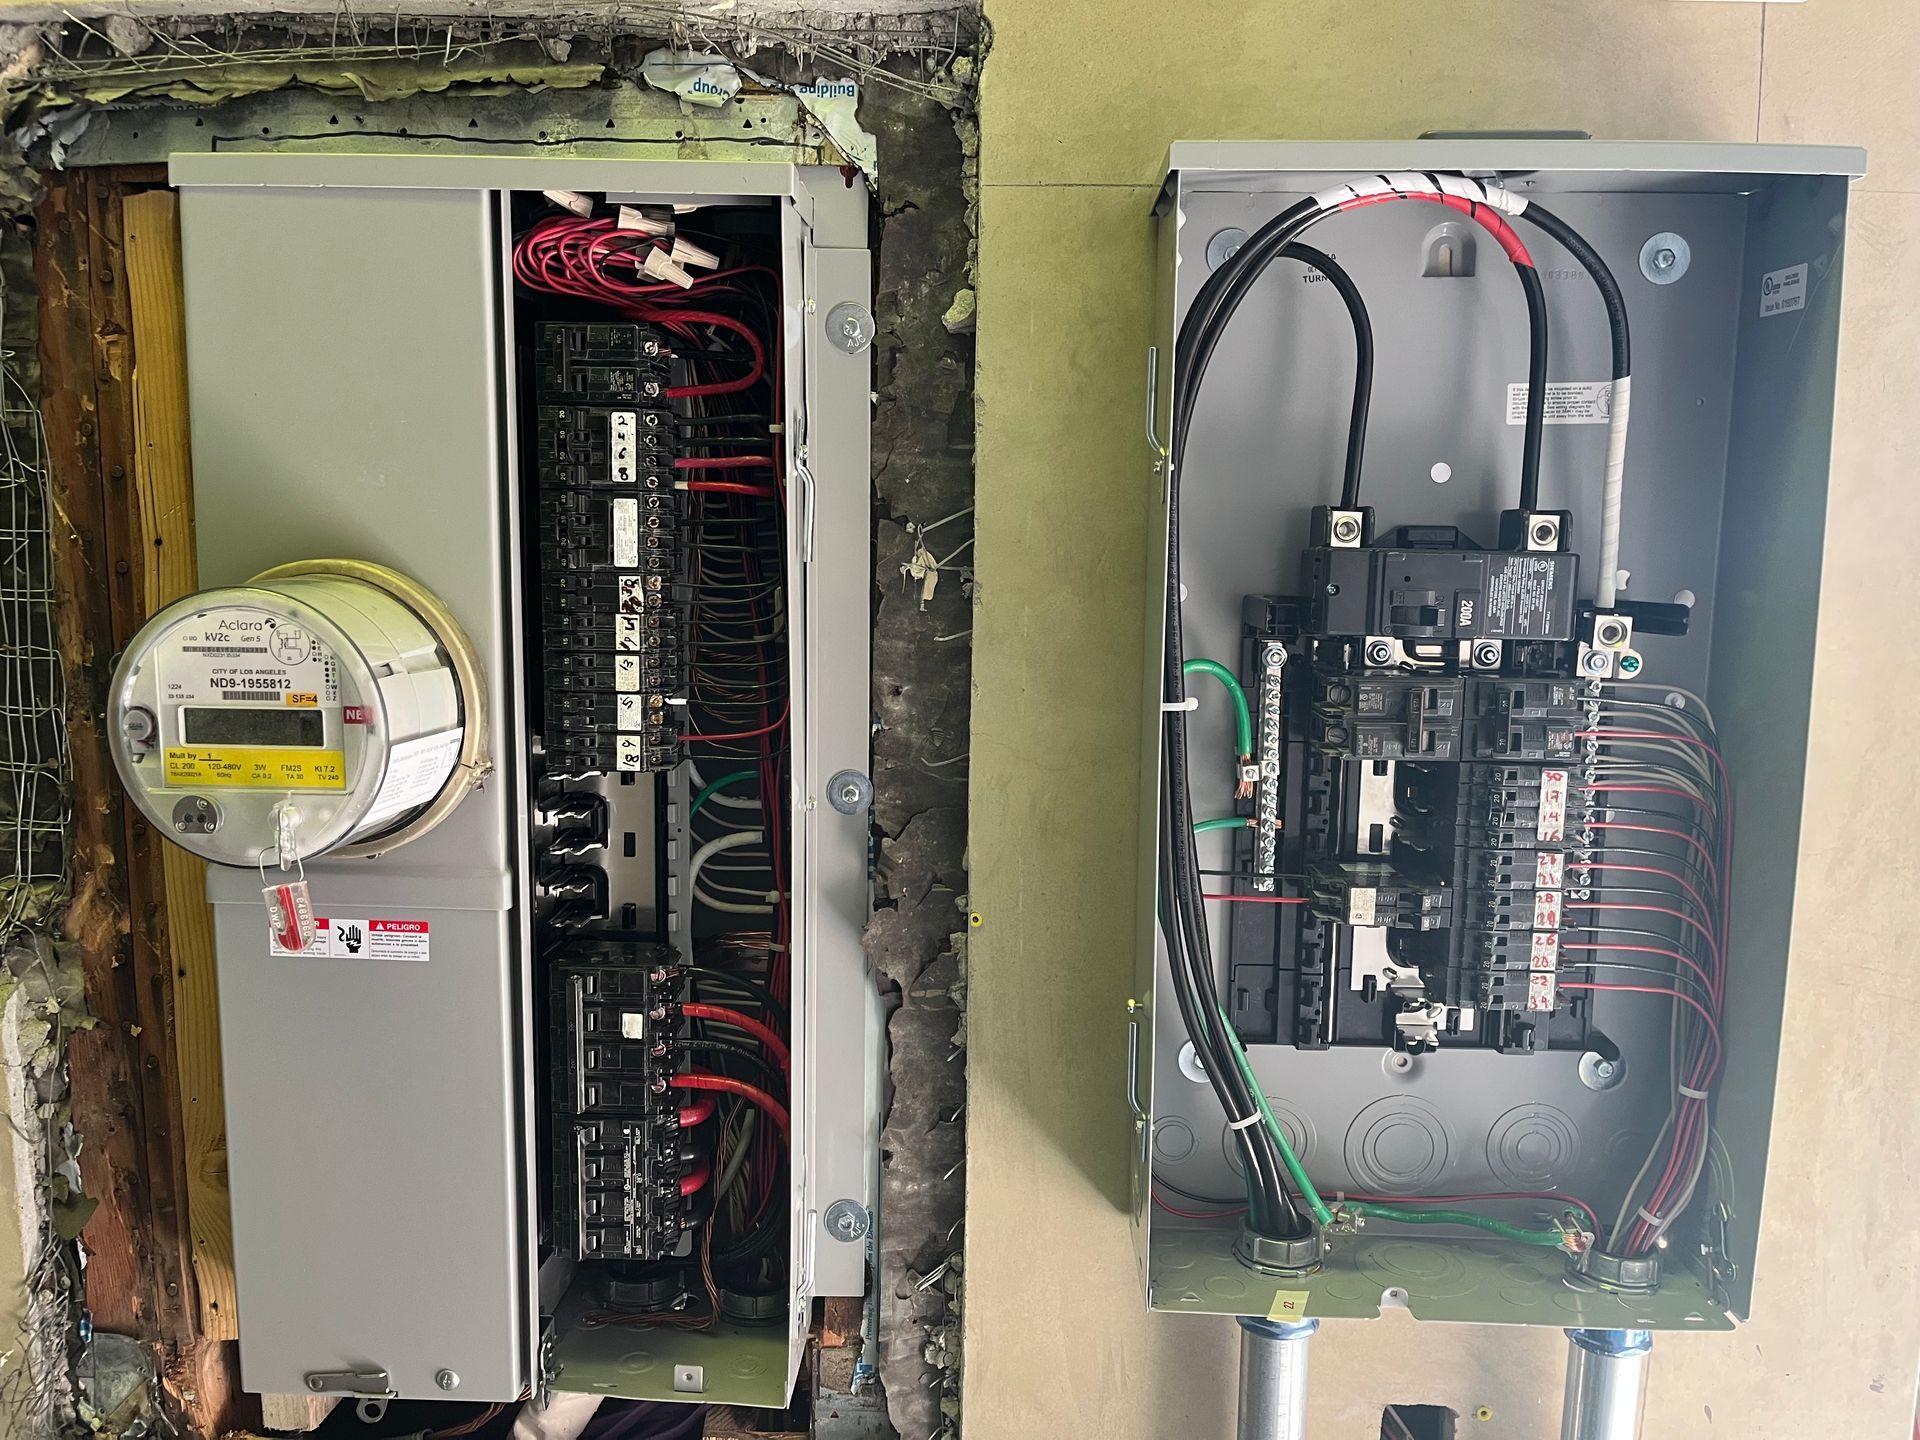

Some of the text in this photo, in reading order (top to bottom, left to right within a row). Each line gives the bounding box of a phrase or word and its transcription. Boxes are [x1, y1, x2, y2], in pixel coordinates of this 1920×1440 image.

[618, 416, 628, 426] 2
[618, 447, 627, 459] 6
[618, 467, 628, 480] 8
[1460, 600, 1474, 626] 200A
[218, 620, 263, 631] Aclara
[204, 632, 230, 642] kV2c
[620, 659, 634, 670] 13
[210, 678, 291, 690] ND9-1955812
[292, 694, 318, 704] SF=4
[622, 754, 640, 766] 18
[1546, 771, 1563, 782] 30
[1546, 790, 1560, 802] 17
[1544, 812, 1560, 822] 14
[1544, 830, 1560, 842] 16
[1538, 872, 1556, 885] 21
[1536, 893, 1554, 904] 28
[270, 906, 281, 928] DWP
[1536, 933, 1556, 946] 26
[1532, 956, 1549, 968] 20
[1531, 976, 1548, 986] 22
